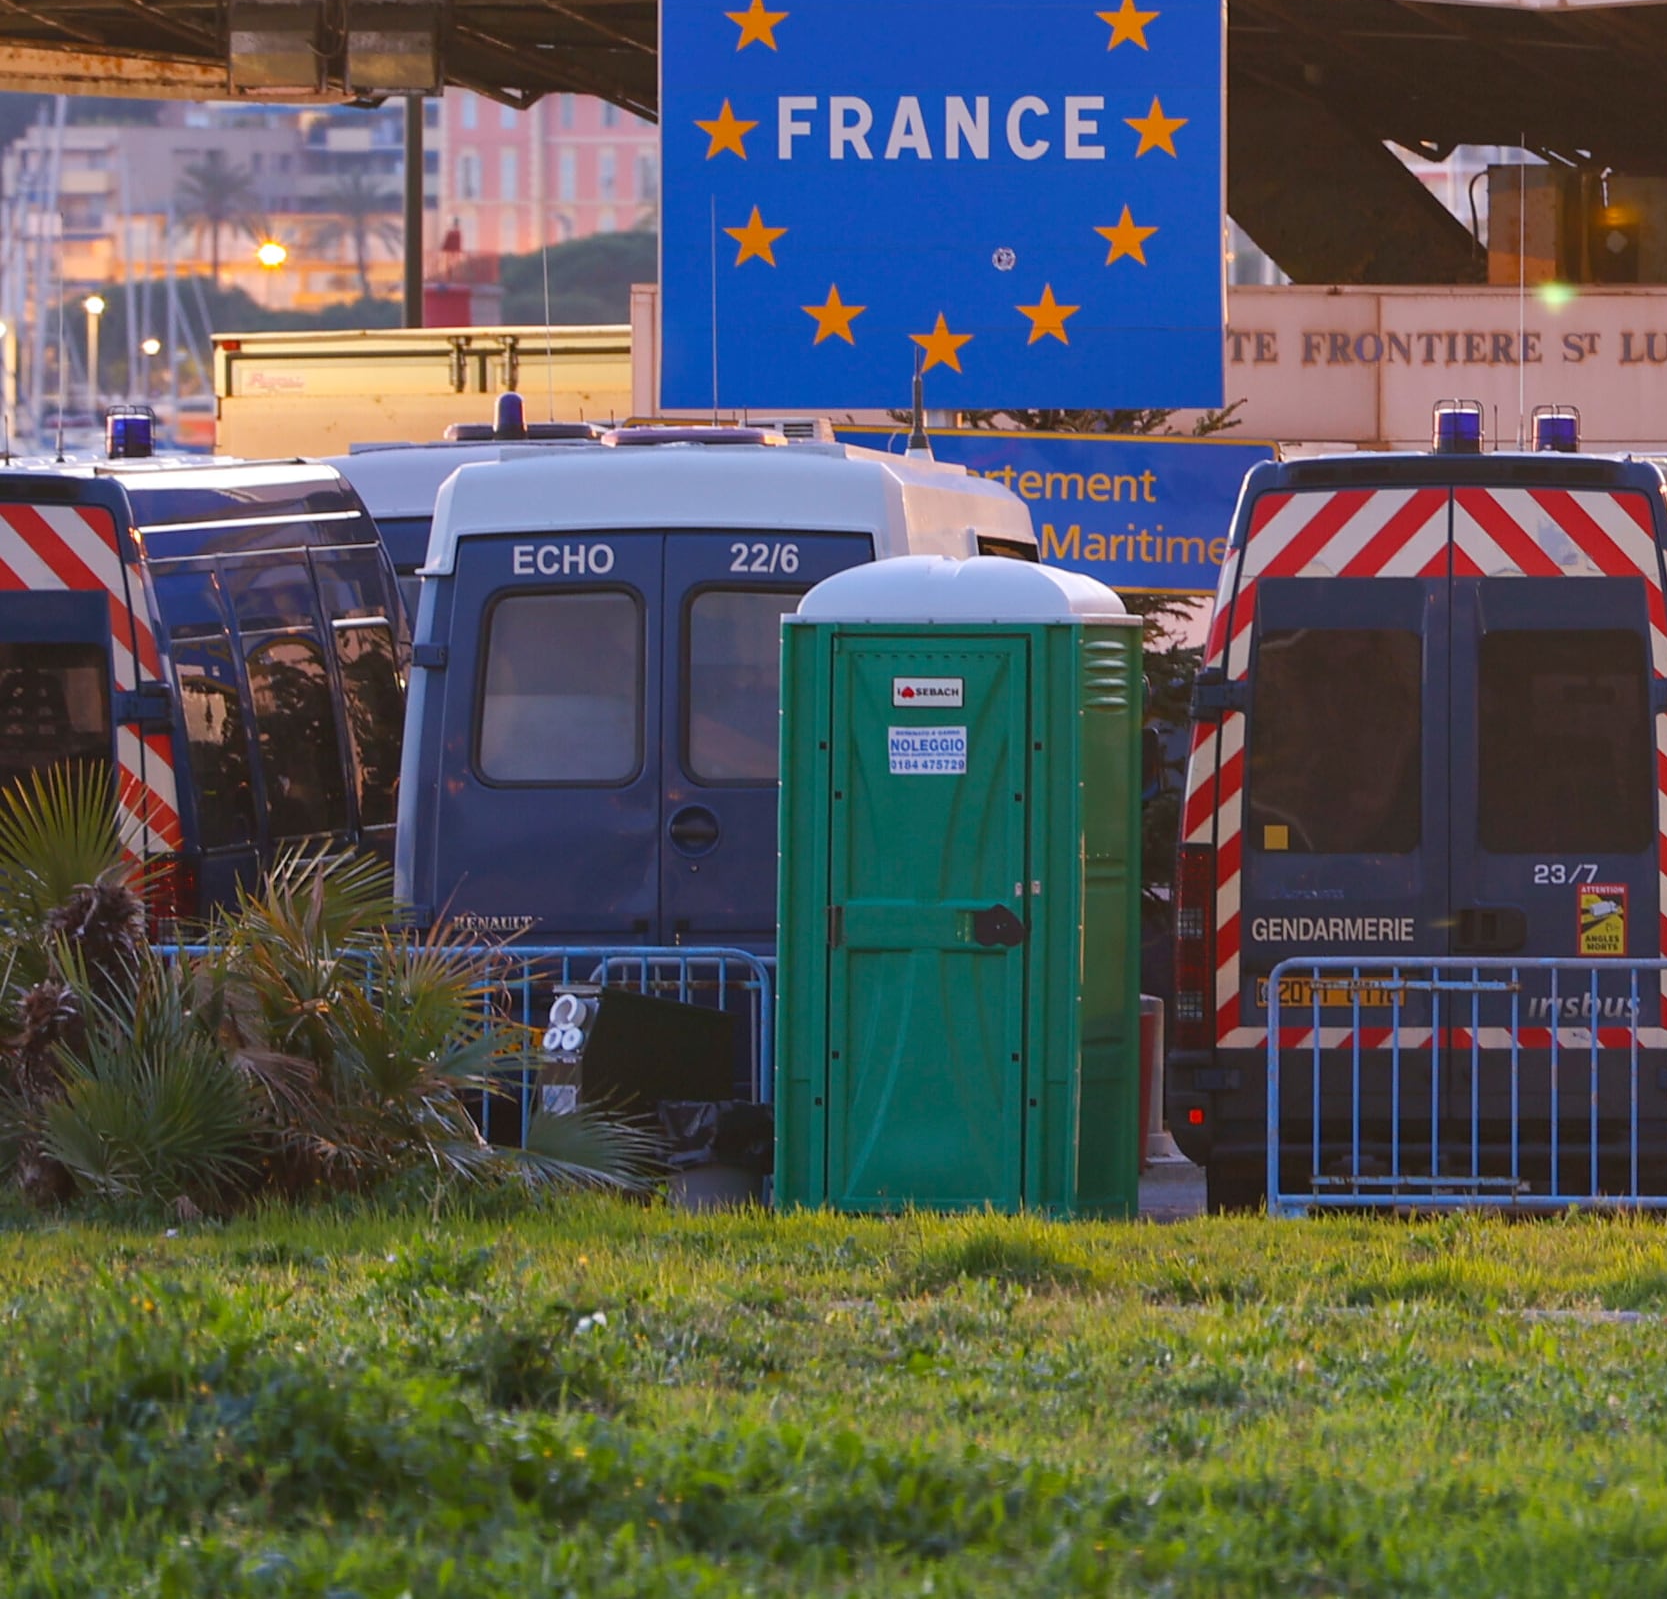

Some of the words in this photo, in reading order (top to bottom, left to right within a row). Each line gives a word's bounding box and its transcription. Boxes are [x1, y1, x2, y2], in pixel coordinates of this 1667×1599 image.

[777, 95, 1106, 161] FRANCE
[1301, 330, 1543, 365] FRONTIERE
[512, 543, 614, 574] ECHO
[730, 542, 800, 574] 22/6
[916, 687, 959, 696] SEBACH
[891, 738, 964, 751] NOLEGGIO
[891, 759, 918, 770] 0184
[1534, 864, 1598, 884] 23/7
[1581, 886, 1625, 894] ATTENTION
[452, 915, 533, 930] RENAULT
[1252, 918, 1414, 941] GENDARMERIE
[1585, 934, 1620, 943] ANGLES
[1587, 943, 1619, 951] MORTS
